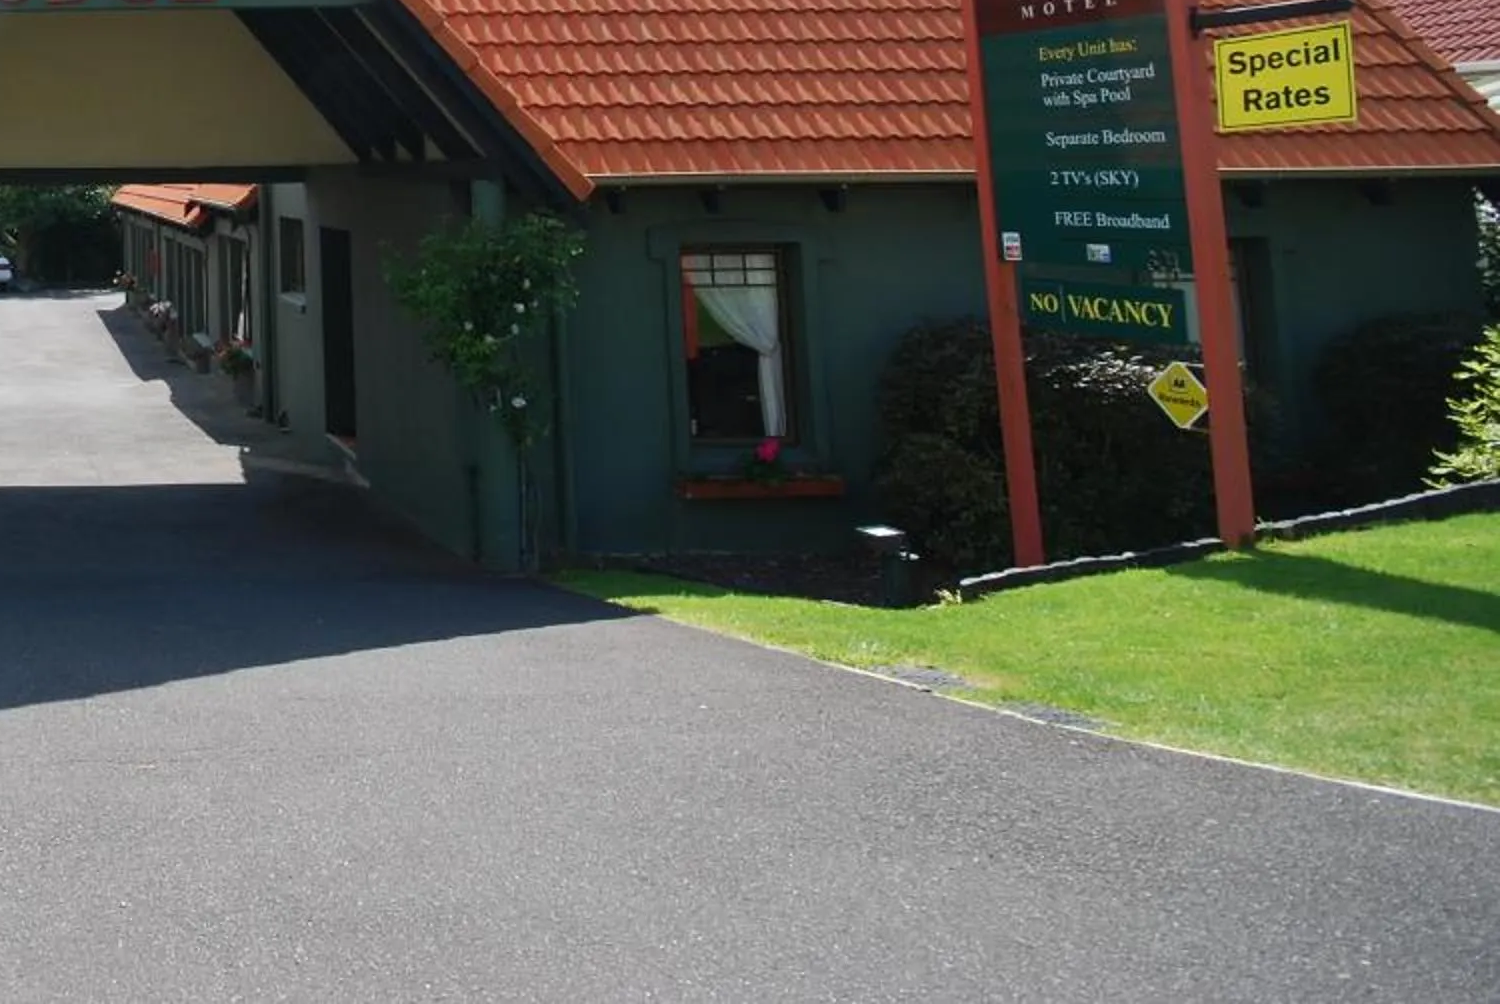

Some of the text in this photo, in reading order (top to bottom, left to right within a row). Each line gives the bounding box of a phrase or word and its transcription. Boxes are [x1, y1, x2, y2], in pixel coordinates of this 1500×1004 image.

[1039, 37, 1138, 61] Every Unit has:
[1228, 37, 1341, 77] Special
[1041, 61, 1155, 88] Private Courtyard
[1043, 86, 1132, 108] with Spa Pool
[1243, 85, 1331, 113] Rates
[1045, 128, 1166, 149] Separate Bedroom
[1050, 170, 1139, 188] 2 TV's (SKY)
[1054, 211, 1171, 229] FREE Broadband
[1030, 293, 1173, 328] NO VACANCY
